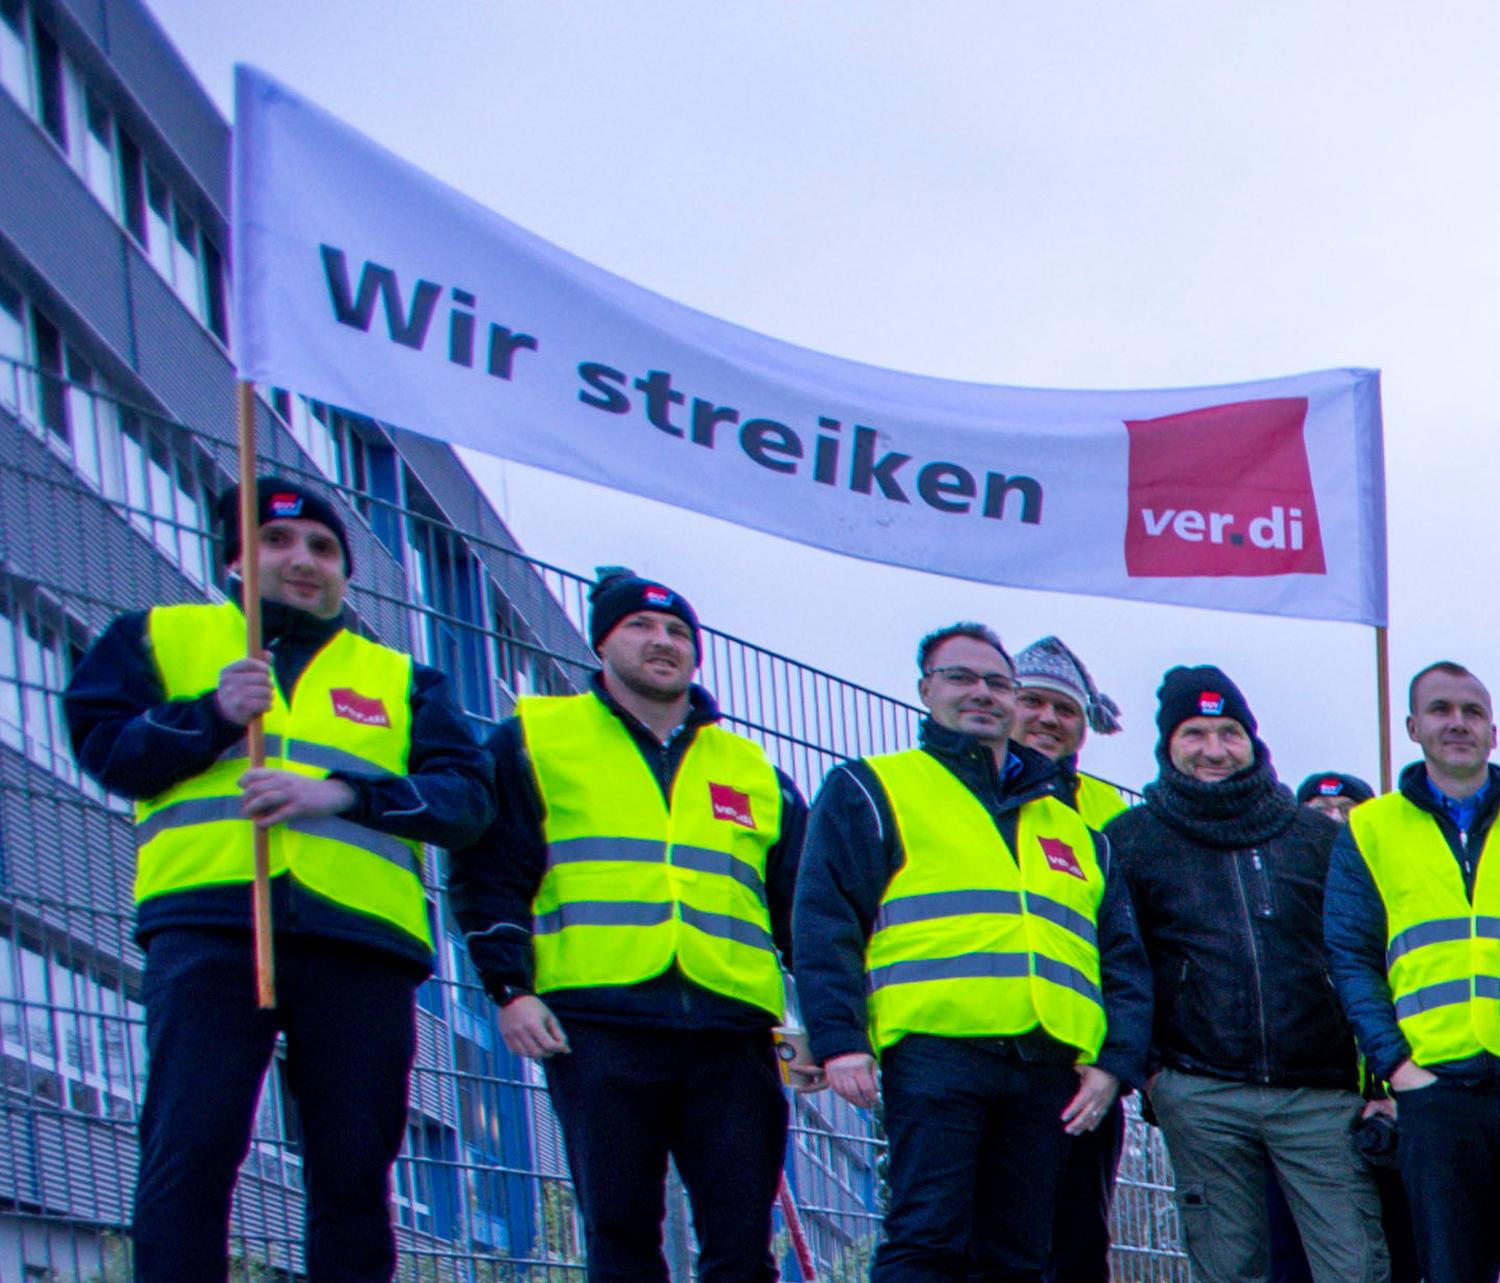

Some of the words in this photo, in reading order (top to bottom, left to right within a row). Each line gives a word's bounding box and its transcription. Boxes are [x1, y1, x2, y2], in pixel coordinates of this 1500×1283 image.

[319, 242, 539, 382] Wir
[576, 360, 1044, 525] streiken
[1141, 506, 1304, 550] ver.di
